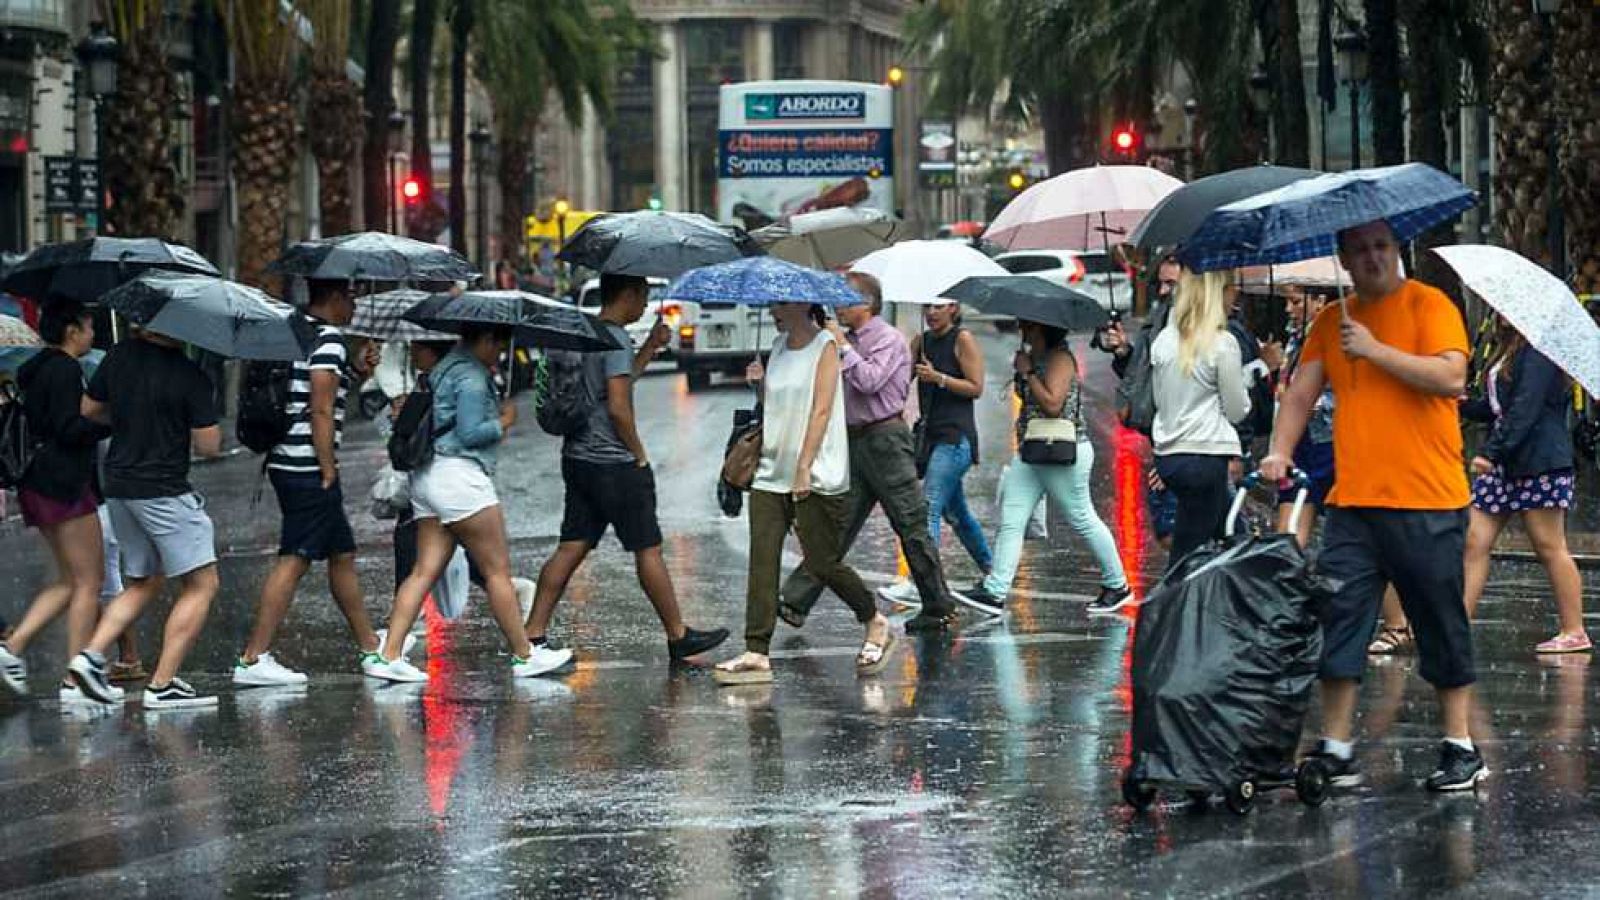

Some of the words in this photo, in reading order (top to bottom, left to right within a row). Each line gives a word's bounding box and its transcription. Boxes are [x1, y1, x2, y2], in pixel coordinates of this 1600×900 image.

[778, 97, 859, 110] ABORDO
[729, 133, 798, 152] ¿Quiere
[803, 132, 879, 151] calidad?
[728, 156, 782, 173] Somos
[787, 156, 884, 174] especialistas
